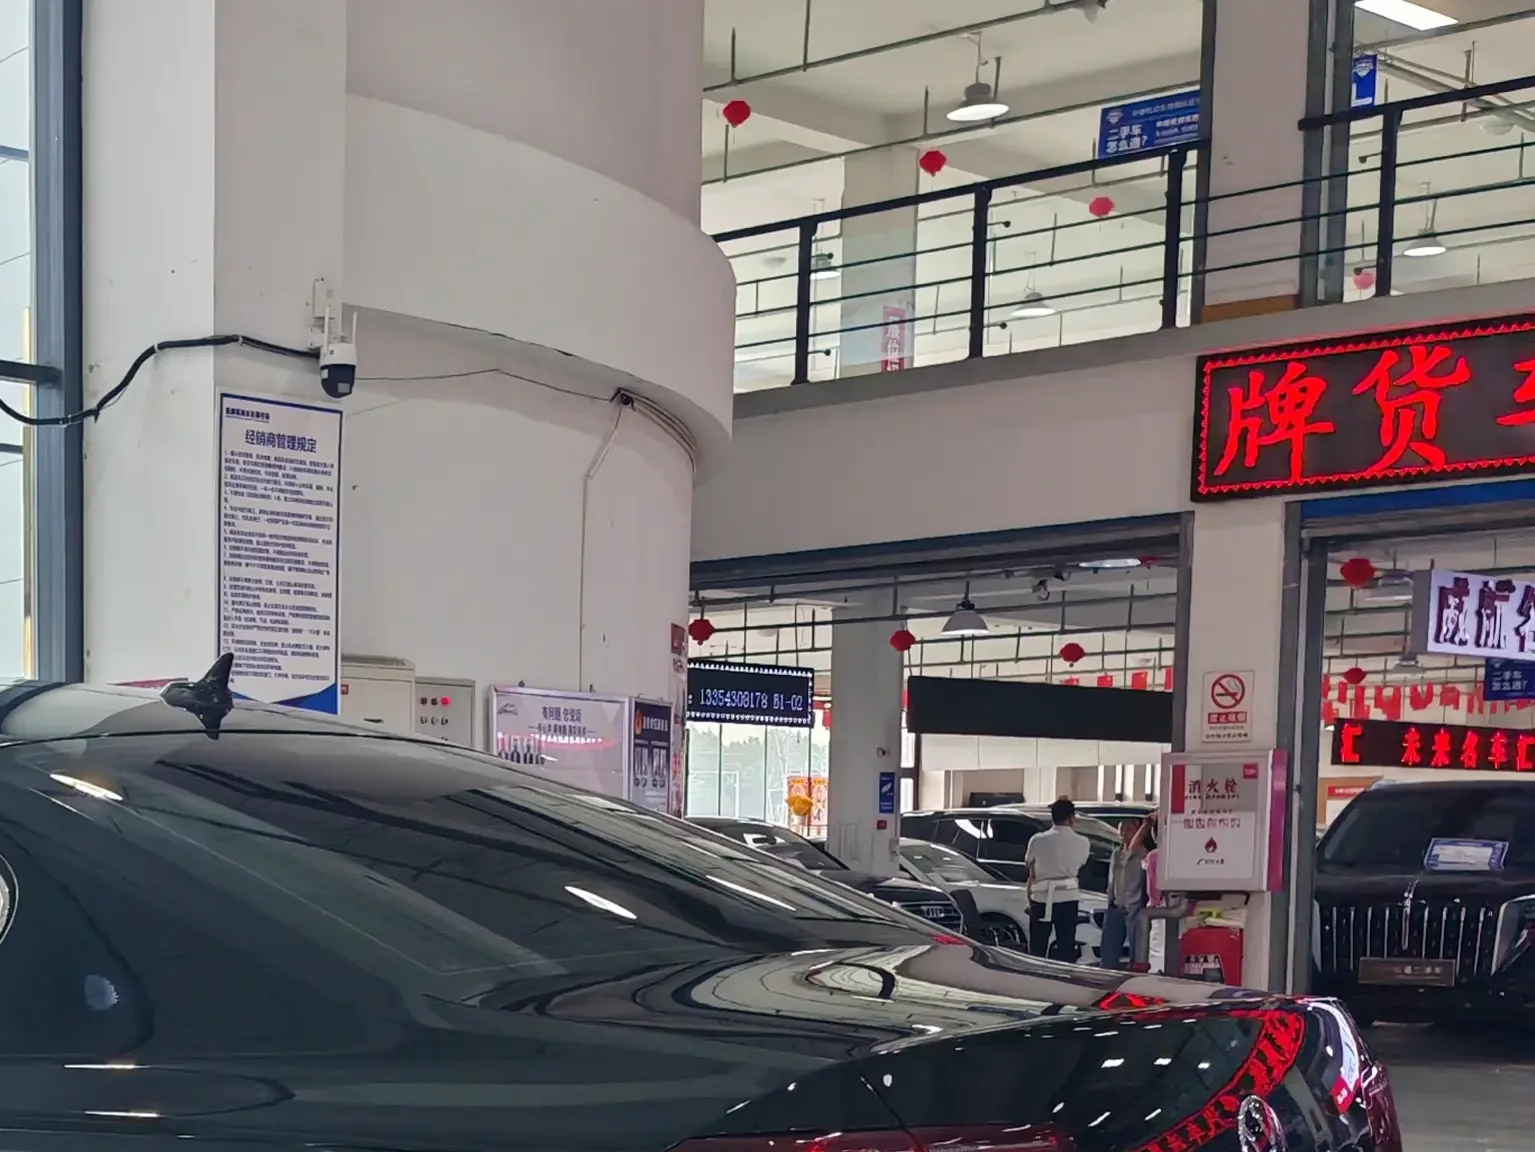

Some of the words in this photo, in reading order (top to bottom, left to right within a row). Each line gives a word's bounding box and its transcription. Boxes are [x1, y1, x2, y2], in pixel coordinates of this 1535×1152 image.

[245, 429, 317, 453] 经销商管理规定
[773, 693, 803, 711] B1-02
[1188, 778, 1238, 794] 消火栓
